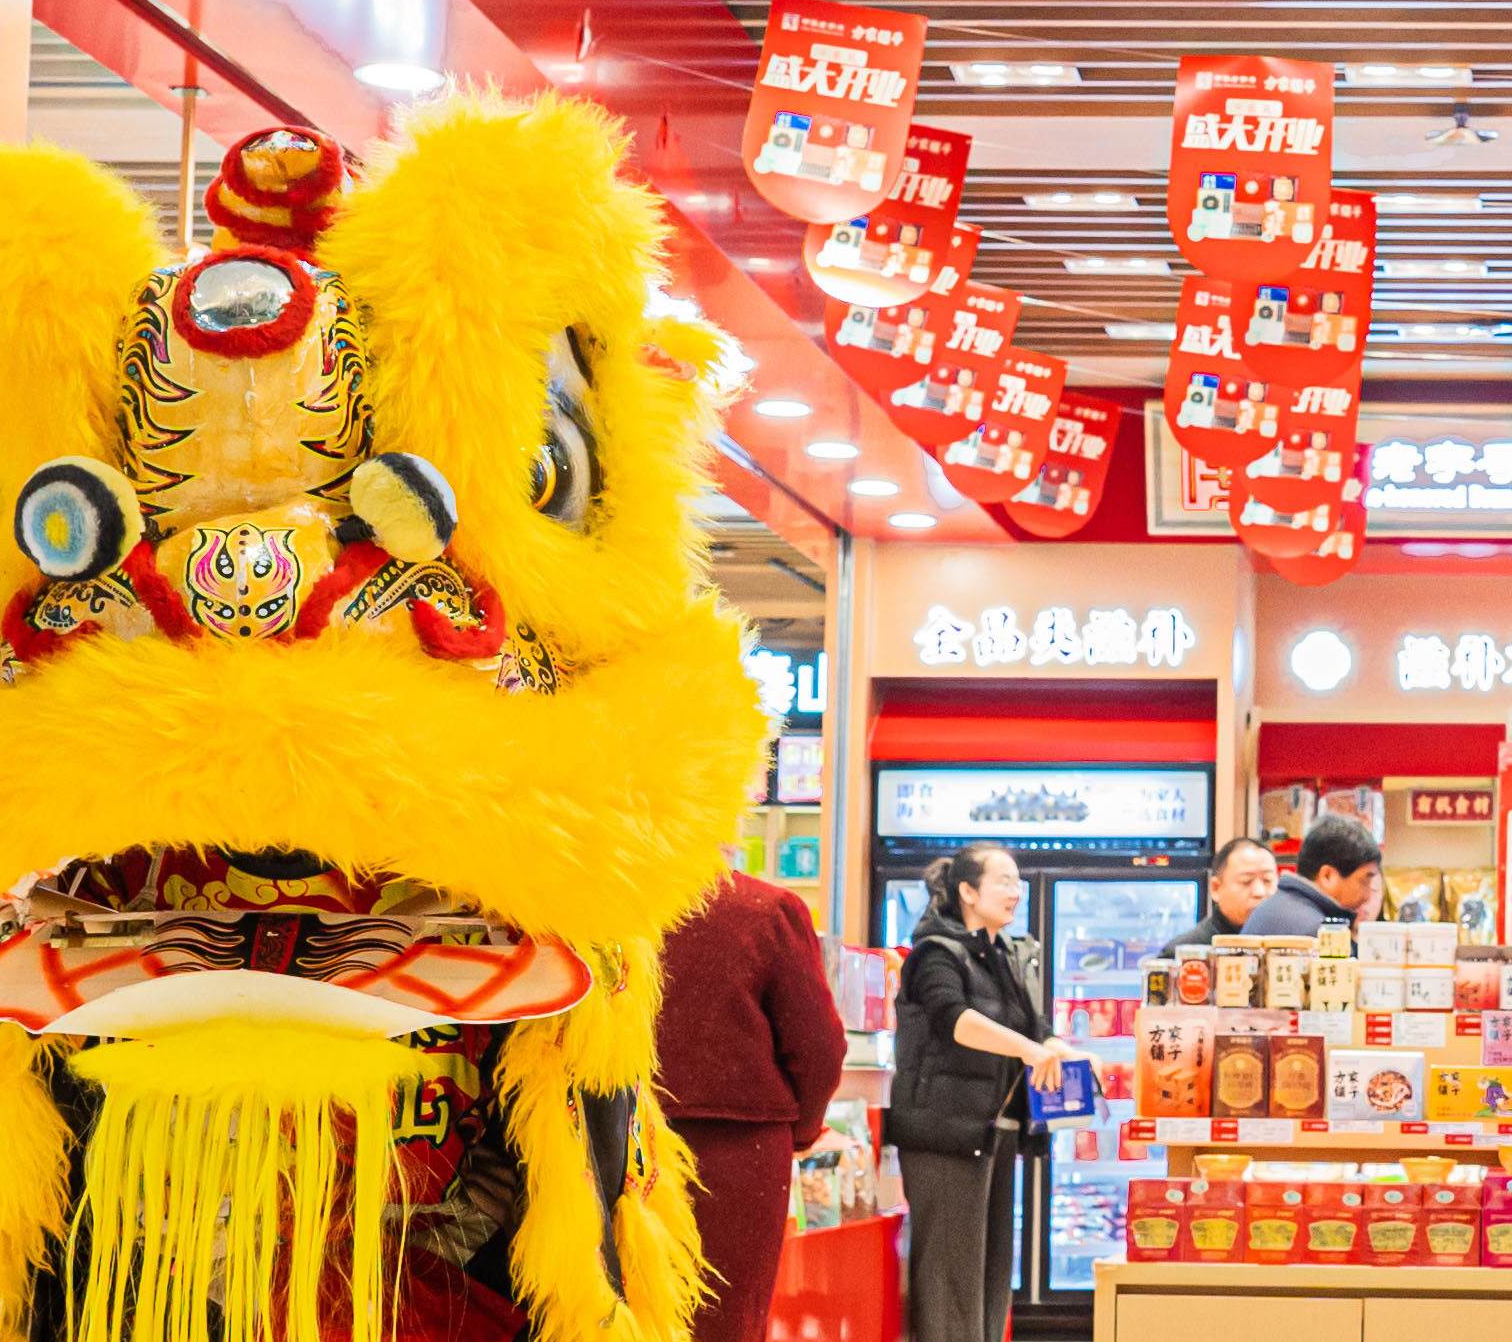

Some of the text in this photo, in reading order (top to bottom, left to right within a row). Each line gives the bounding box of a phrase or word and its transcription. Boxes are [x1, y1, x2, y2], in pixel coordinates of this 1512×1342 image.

[760, 53, 907, 107] 盛大开业
[1181, 114, 1325, 155] 盛大开业
[889, 172, 954, 209] 开业
[1300, 239, 1368, 273] 开业
[946, 321, 1004, 358] 开业
[1291, 387, 1352, 416] 开业
